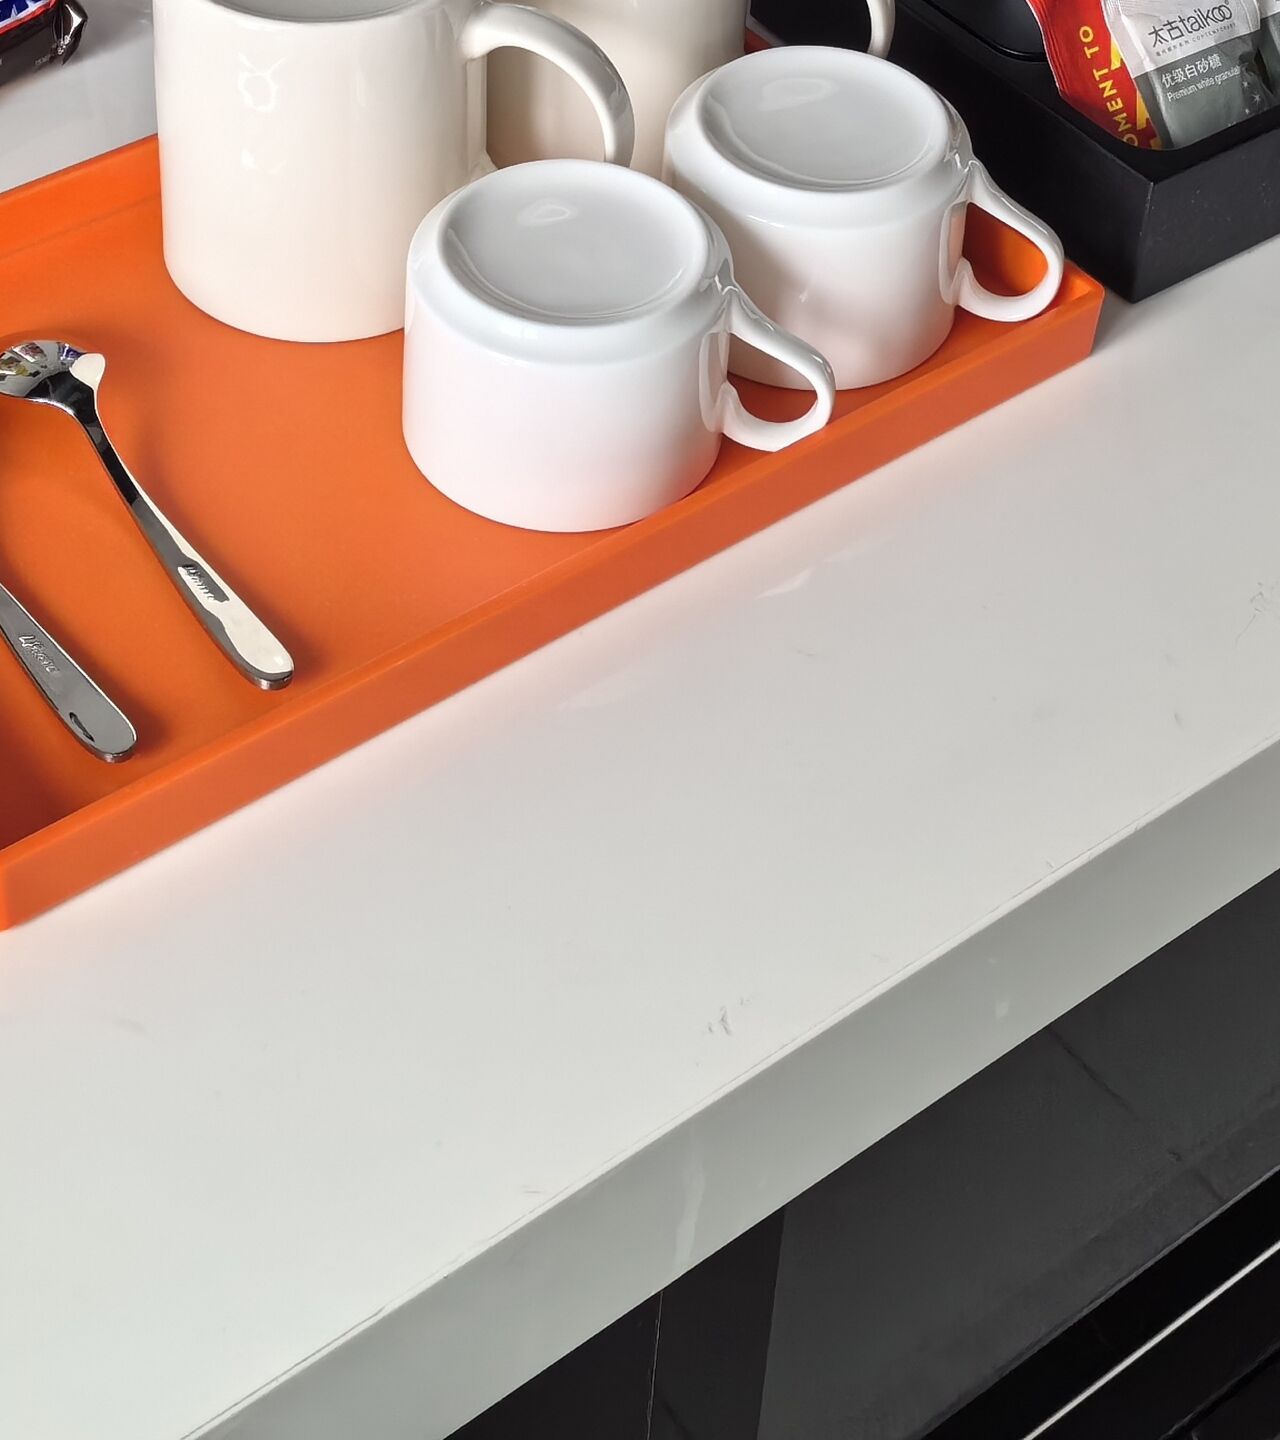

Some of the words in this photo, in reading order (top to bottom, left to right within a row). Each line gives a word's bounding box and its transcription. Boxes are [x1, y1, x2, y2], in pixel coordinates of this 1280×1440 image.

[1079, 25, 1100, 59] TO
[1161, 52, 1223, 90] 优级白砂糖
[1167, 84, 1197, 103] Premium
[1197, 74, 1215, 90] white
[1093, 67, 1139, 148] OMENT
